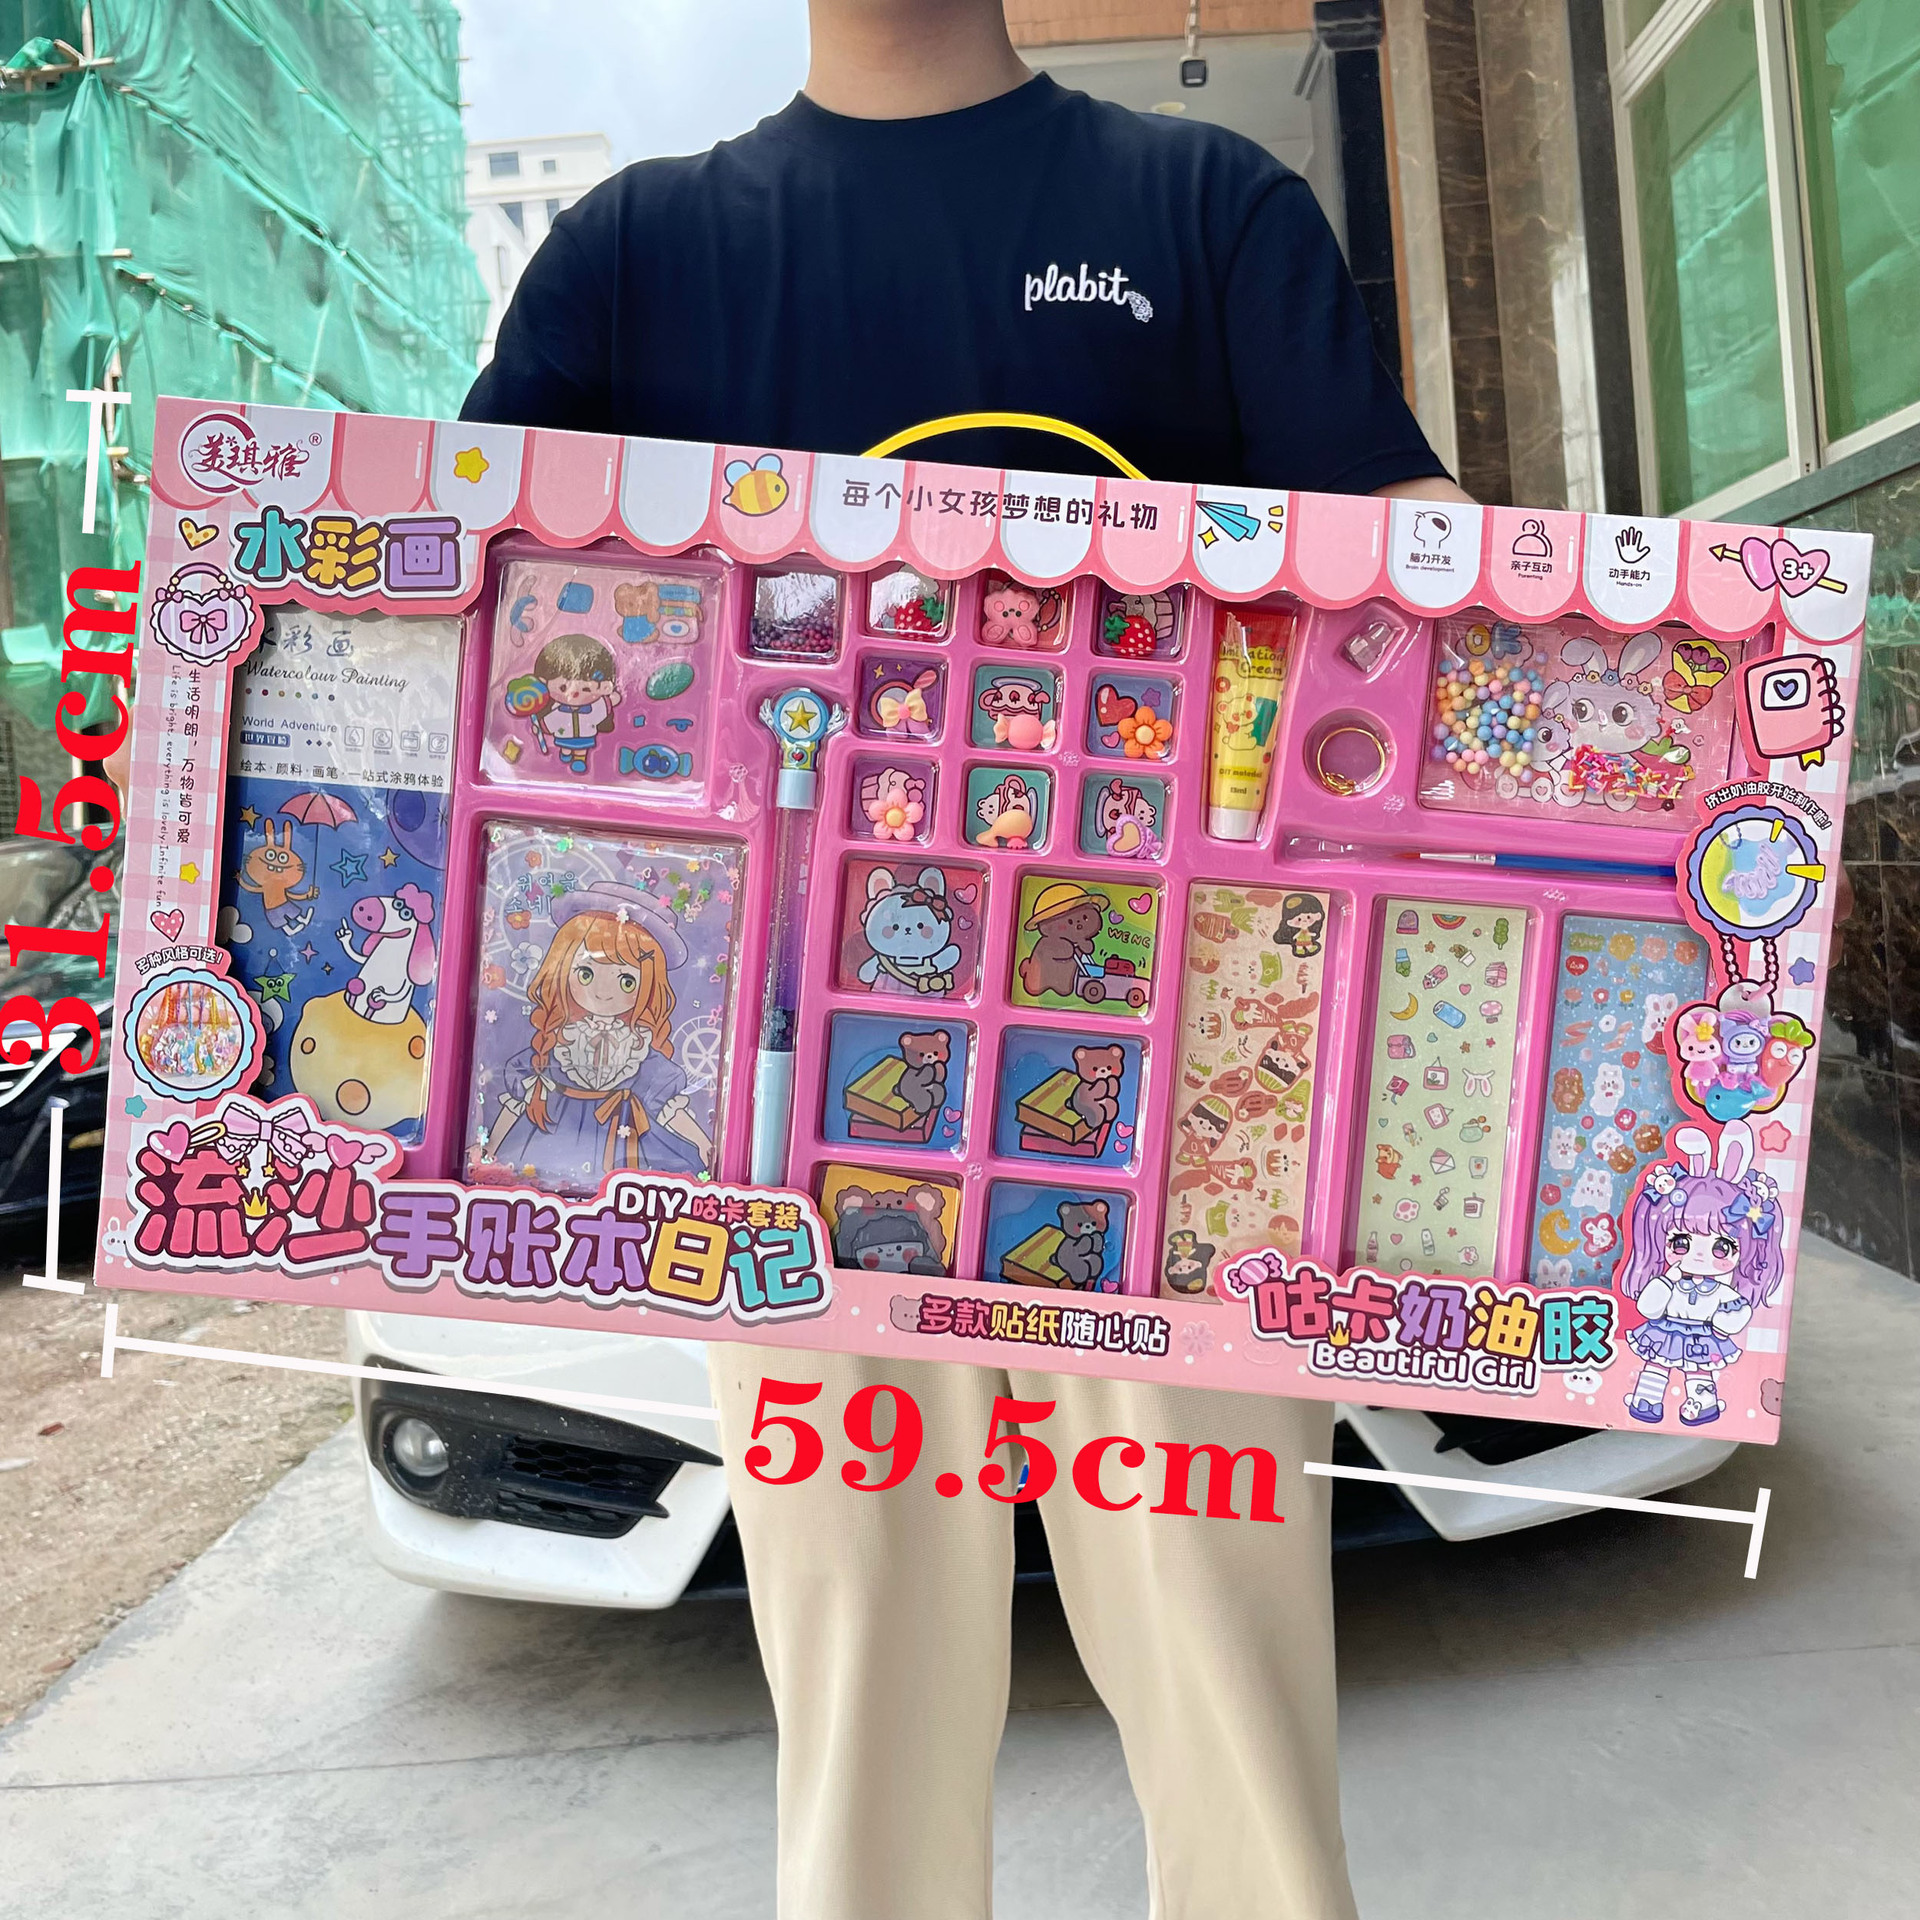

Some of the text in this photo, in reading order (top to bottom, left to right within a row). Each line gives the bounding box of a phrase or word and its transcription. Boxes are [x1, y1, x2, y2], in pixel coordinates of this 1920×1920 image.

[1024, 263, 1131, 312] plabit
[188, 432, 310, 485] 美琪雅
[842, 479, 1159, 532] 每个小女孩梦想的礼物
[236, 507, 461, 591] 水彩画
[1409, 552, 1452, 566] 脑力开发
[1510, 560, 1552, 573] 亲子互动
[1782, 558, 1815, 580] 3+
[1608, 568, 1651, 581] 动手能力
[1221, 644, 1284, 662] Imiation
[246, 661, 410, 693] Watercolour Painting
[242, 716, 337, 733] World Adventure
[616, 1184, 800, 1231] DIY 咕卡套装
[919, 1294, 1171, 1356] 多款贴纸随心贴
[1254, 1267, 1615, 1364] 咕卡奶油胶
[1315, 1344, 1537, 1390] Beautiful Girl
